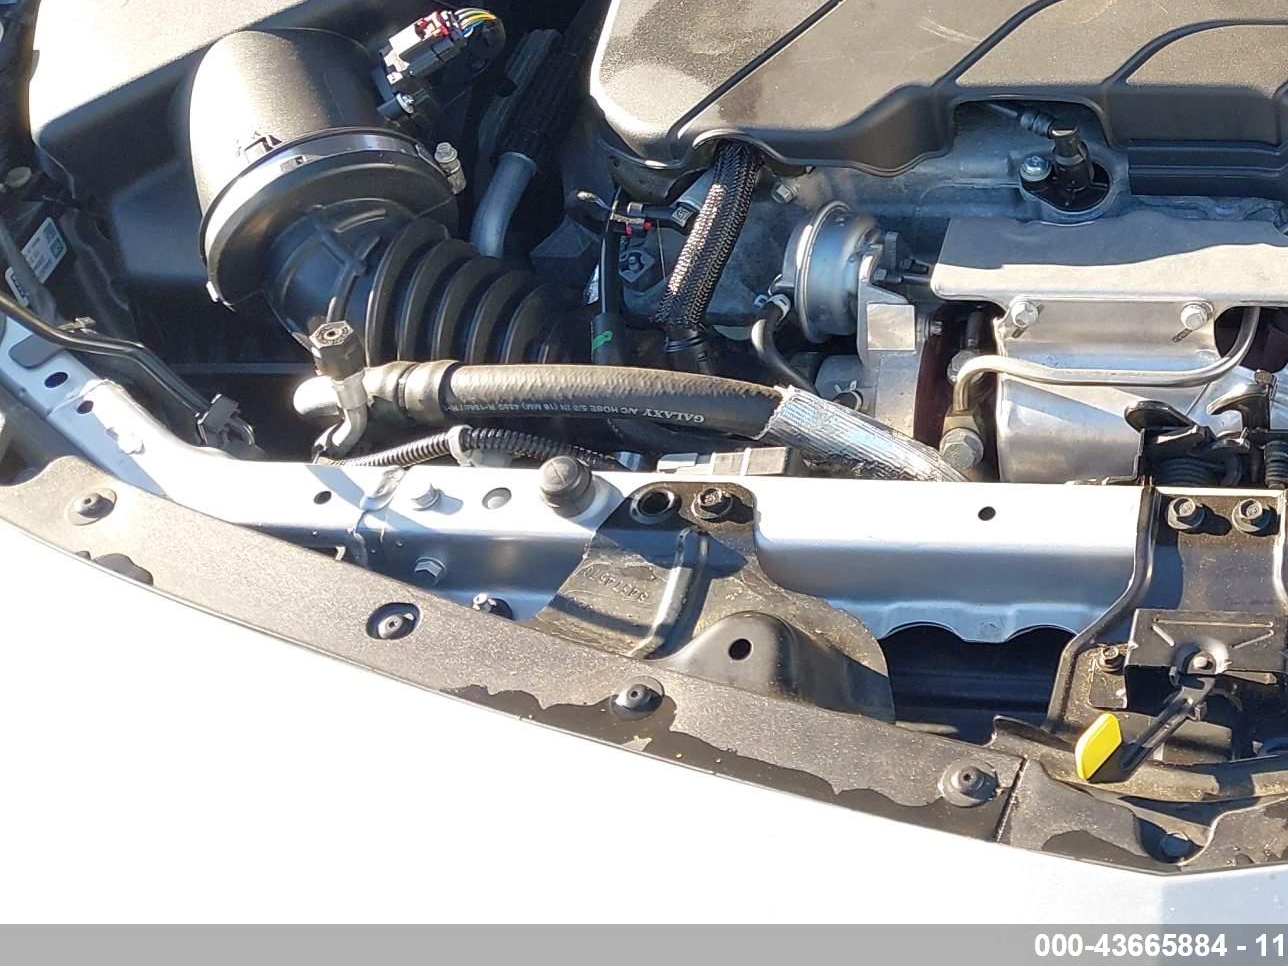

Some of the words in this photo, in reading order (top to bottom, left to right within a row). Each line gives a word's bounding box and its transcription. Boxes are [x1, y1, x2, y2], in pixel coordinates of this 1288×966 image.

[590, 404, 618, 413] HOSE
[620, 406, 639, 415] A/C
[643, 407, 705, 423] GALAXY
